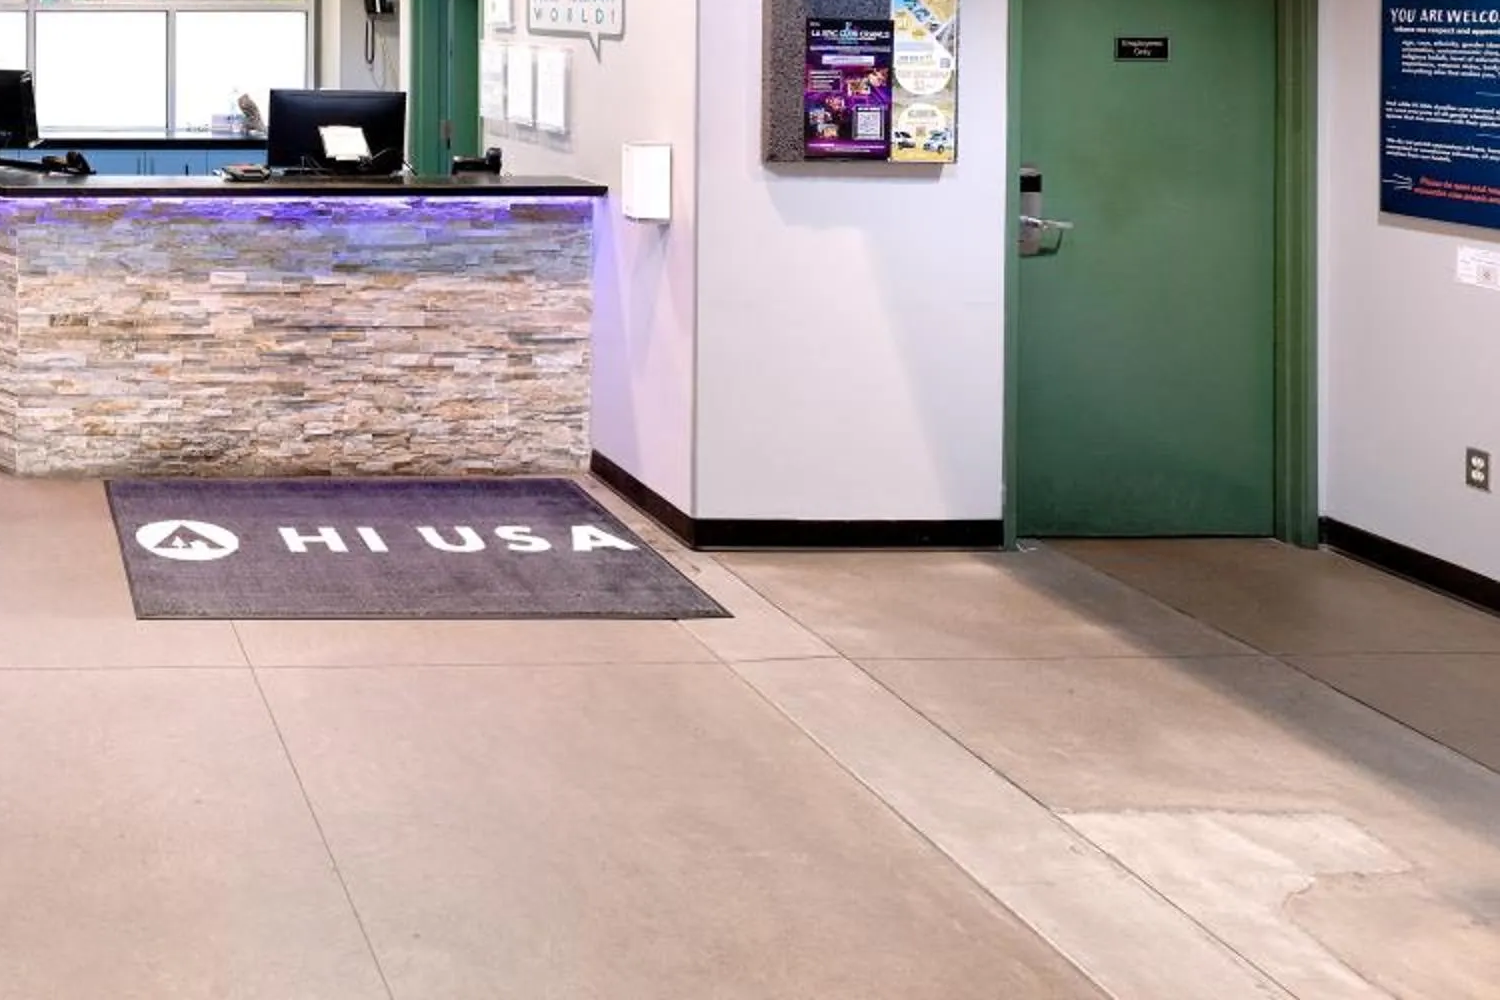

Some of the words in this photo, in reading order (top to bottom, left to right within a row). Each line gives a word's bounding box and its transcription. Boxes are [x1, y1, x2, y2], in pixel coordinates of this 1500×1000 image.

[1390, 8, 1416, 23] YOU
[1420, 8, 1443, 23] ARE
[1446, 9, 1500, 23] WELCO
[279, 526, 389, 552] HI
[418, 526, 639, 552] USA
